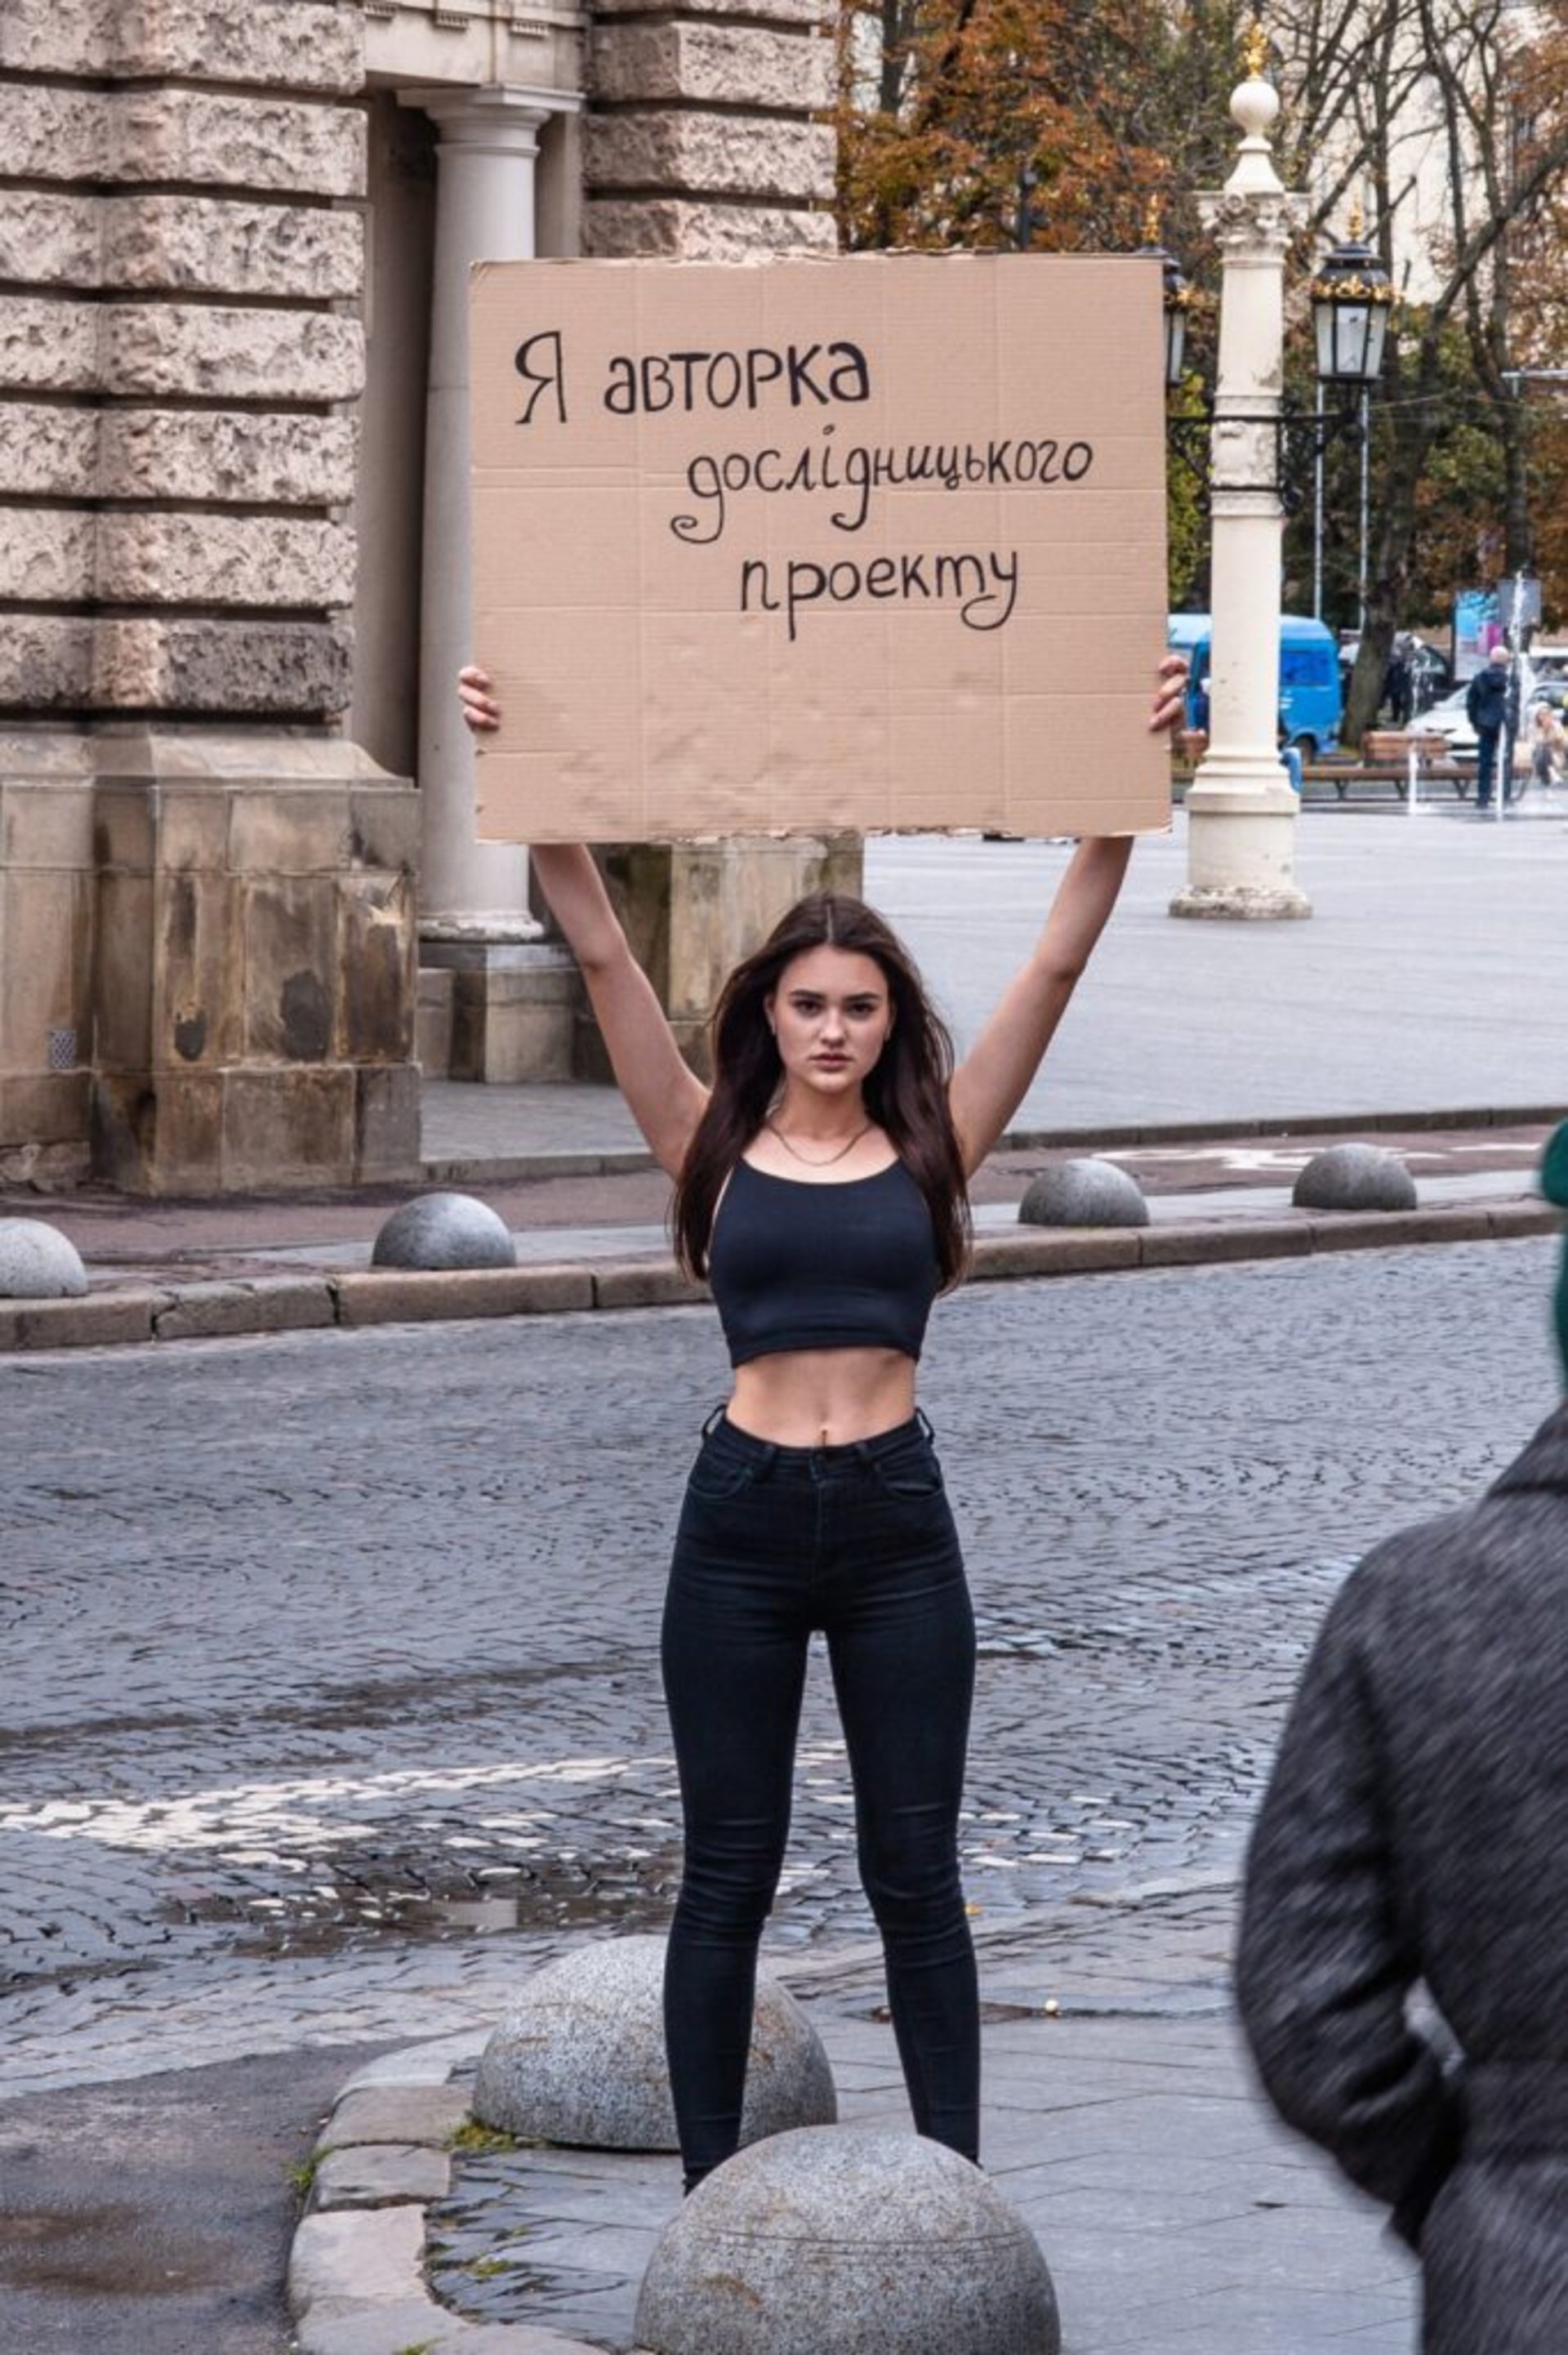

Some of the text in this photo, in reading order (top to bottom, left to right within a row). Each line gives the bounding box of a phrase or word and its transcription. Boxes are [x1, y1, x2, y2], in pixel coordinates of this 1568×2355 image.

[514, 329, 871, 425] Я авторка
[670, 424, 1094, 544] дослідницького
[740, 551, 1018, 641] проекту
